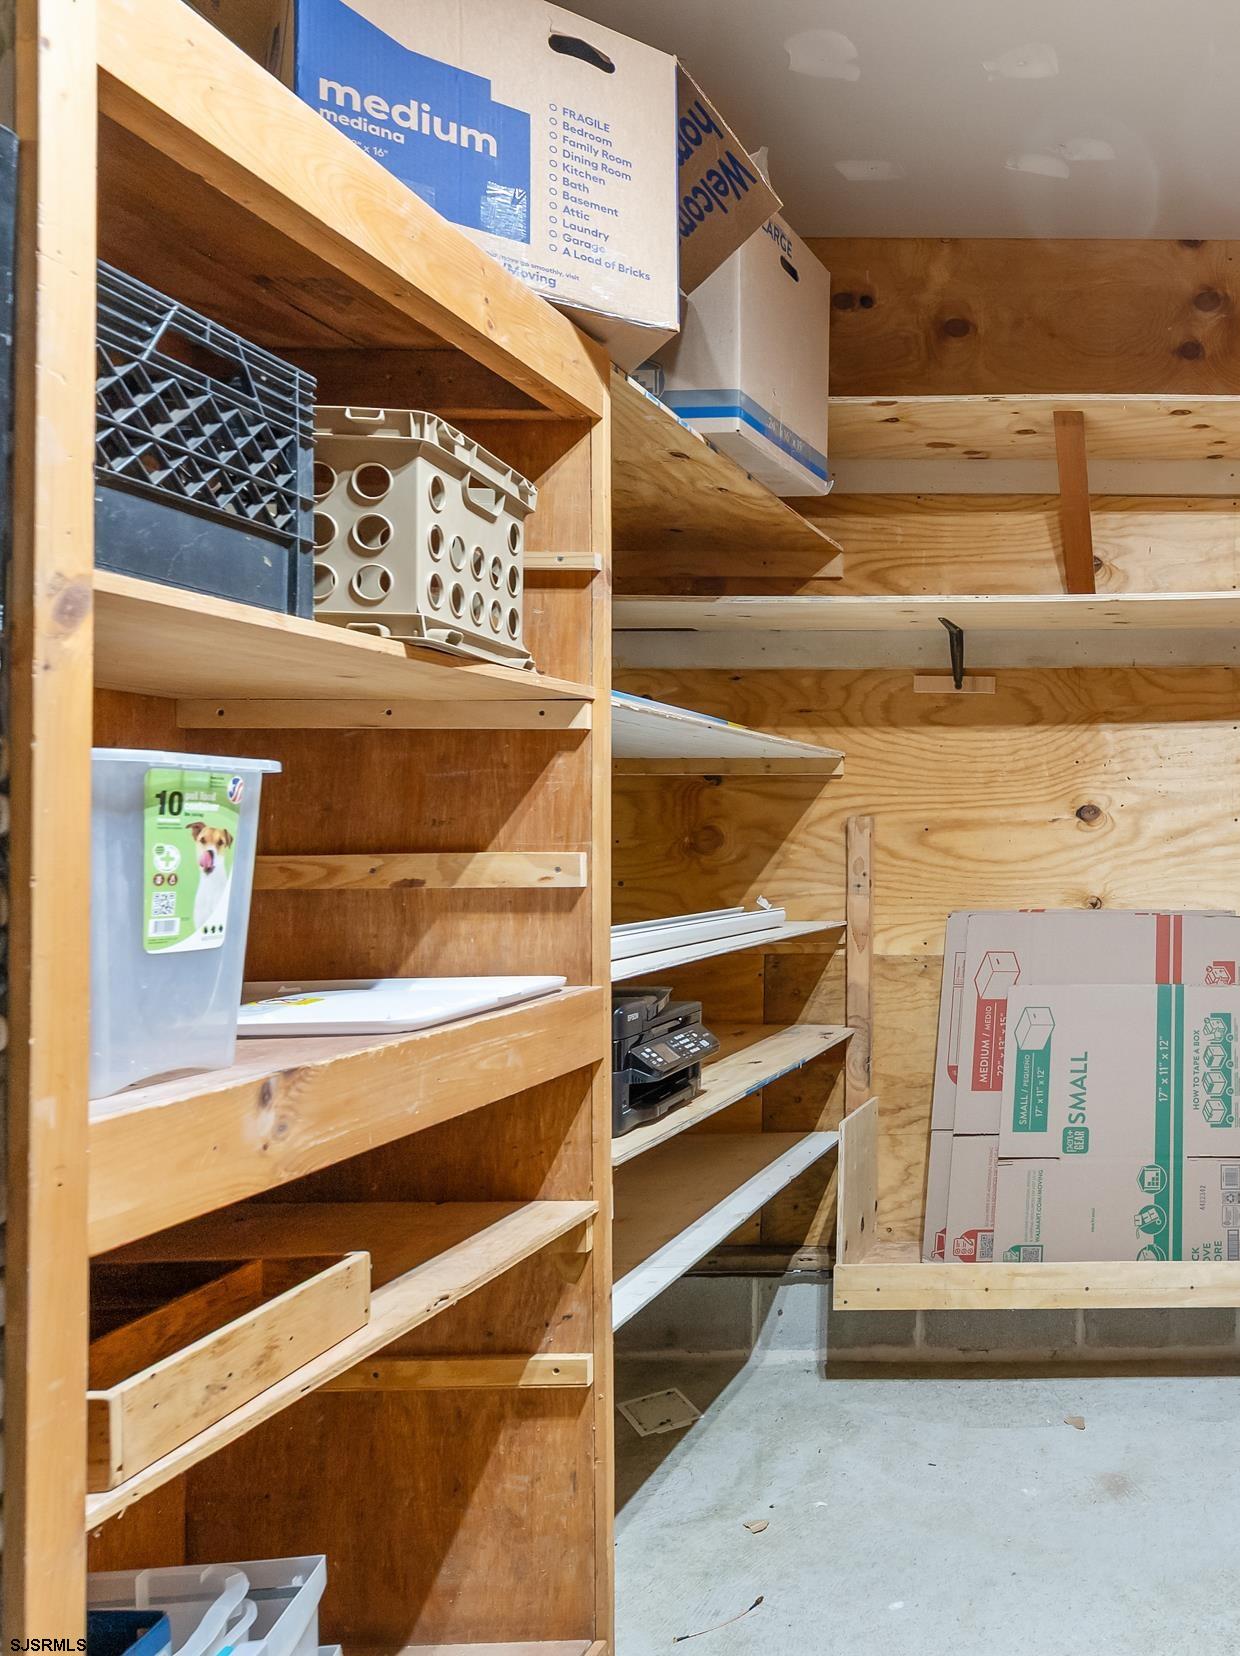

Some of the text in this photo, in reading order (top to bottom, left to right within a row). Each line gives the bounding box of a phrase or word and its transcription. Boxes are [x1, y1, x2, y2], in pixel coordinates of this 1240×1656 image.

[319, 77, 497, 158] medium
[319, 108, 405, 144] mediana
[562, 107, 610, 133] FRAGILE
[562, 121, 613, 147] Bedroom
[677, 100, 724, 167] hom
[562, 135, 632, 168] Family Room
[562, 149, 632, 181] Dining Room
[562, 162, 606, 186] Kitchen
[562, 176, 590, 194] Bath
[678, 150, 757, 242] Welcom
[562, 190, 619, 217] Basement
[562, 205, 590, 221] Attic
[562, 218, 610, 242] Laundry
[562, 233, 606, 253] Garage
[562, 247, 651, 281] A Load of Bricks
[155, 790, 183, 816] 10
[984, 1005, 992, 1031] MEDIO
[1159, 1036, 1168, 1050] 12"
[979, 1039, 990, 1083] MEDIUM
[1037, 1067, 1045, 1079] 12"
[1159, 1062, 1168, 1075] 11"
[1036, 1086, 1044, 1098] 11"
[1068, 1051, 1088, 1124] SMALL
[1159, 1087, 1168, 1102] 17"
[1193, 1078, 1200, 1087] TO
[1019, 1094, 1029, 1125] SMALL
[1035, 1105, 1043, 1117] 17"
[1073, 1131, 1085, 1150] GEAR
[1191, 1247, 1200, 1261] CK
[1213, 1240, 1223, 1261] ORE
